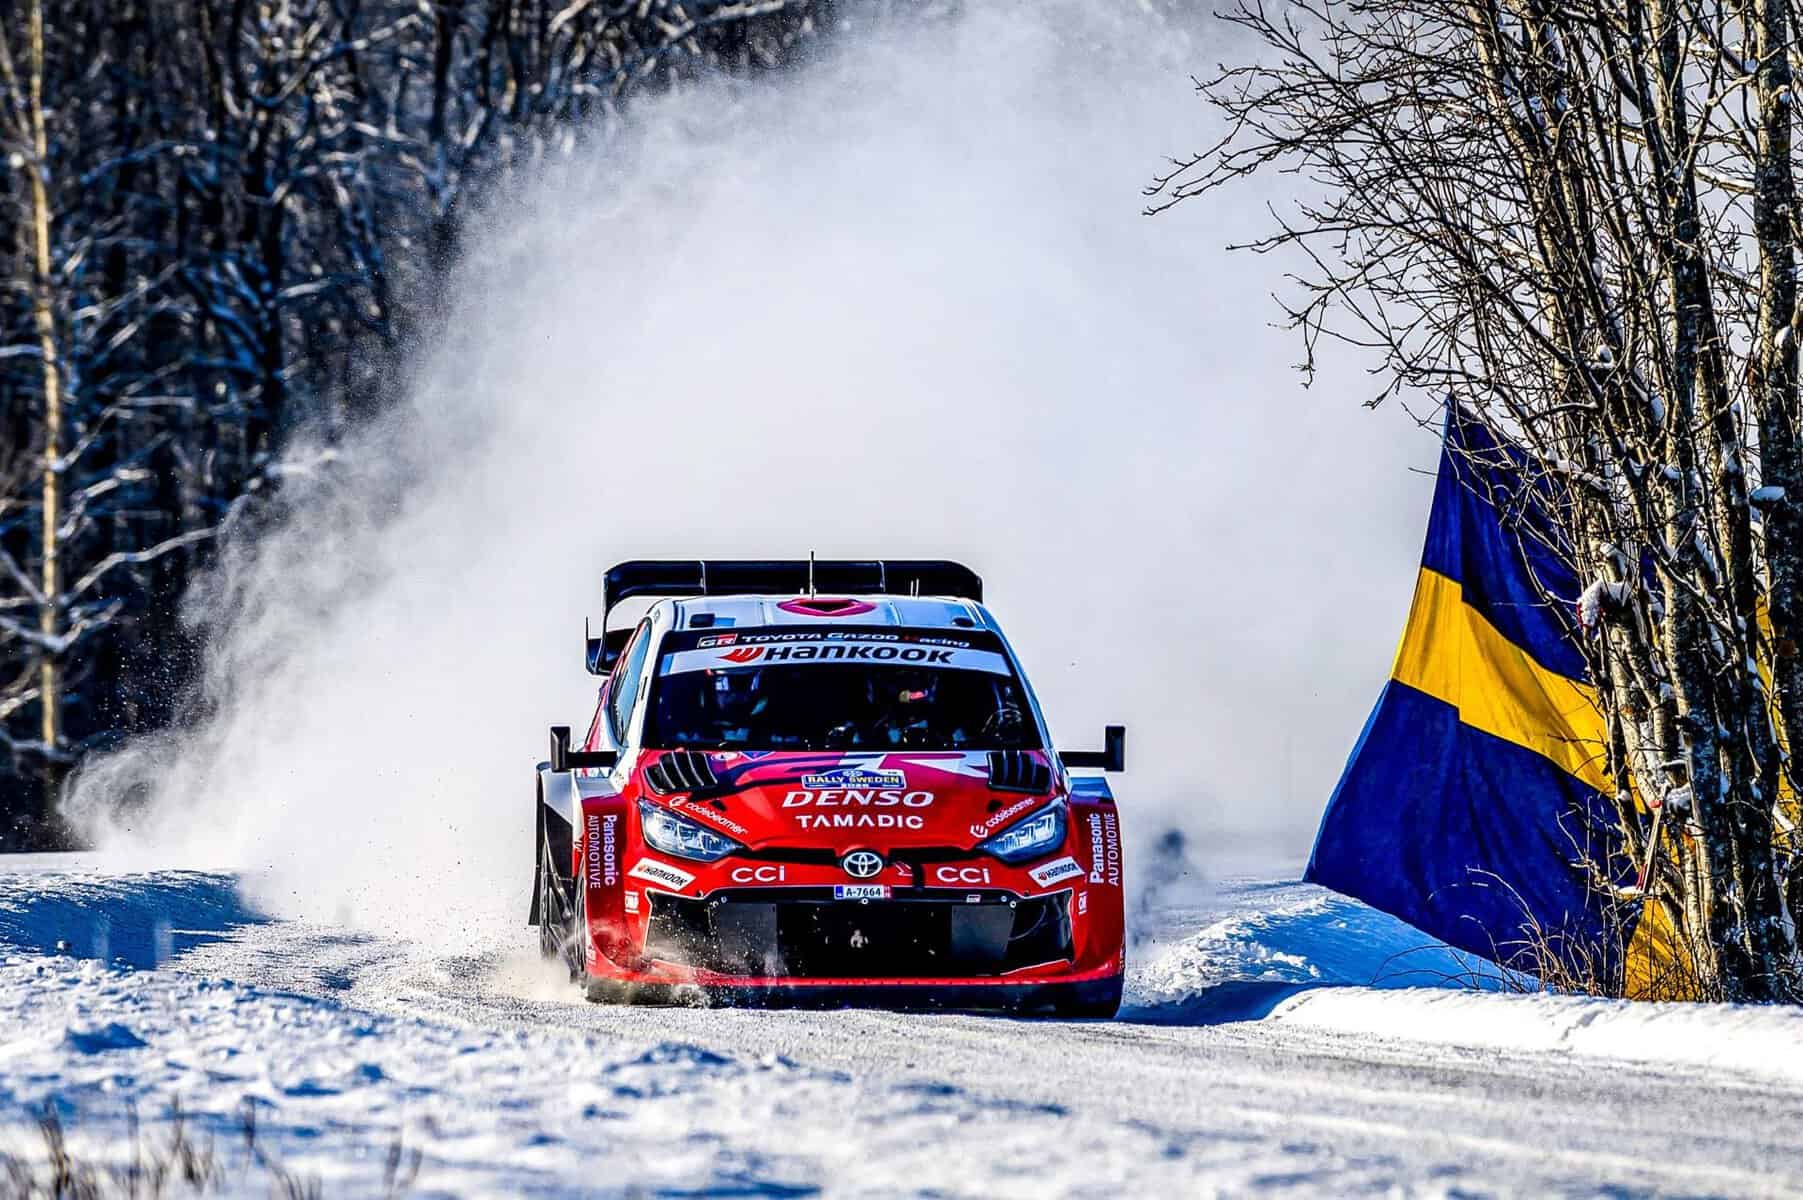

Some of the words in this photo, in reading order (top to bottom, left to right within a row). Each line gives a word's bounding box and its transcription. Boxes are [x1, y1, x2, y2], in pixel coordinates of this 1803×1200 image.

[742, 633, 821, 642] TOYOTA
[808, 775, 844, 783] RALLY
[849, 775, 899, 783] SWEDEN
[782, 790, 934, 807] DENSO
[796, 814, 923, 829] TAMADIC
[588, 815, 601, 889] AUTOMOTIVE
[603, 815, 620, 886] Panasonic
[1086, 813, 1104, 883] Panasonic
[1104, 812, 1119, 887] AUTOMOTIVE
[846, 887, 881, 897] A-7664
